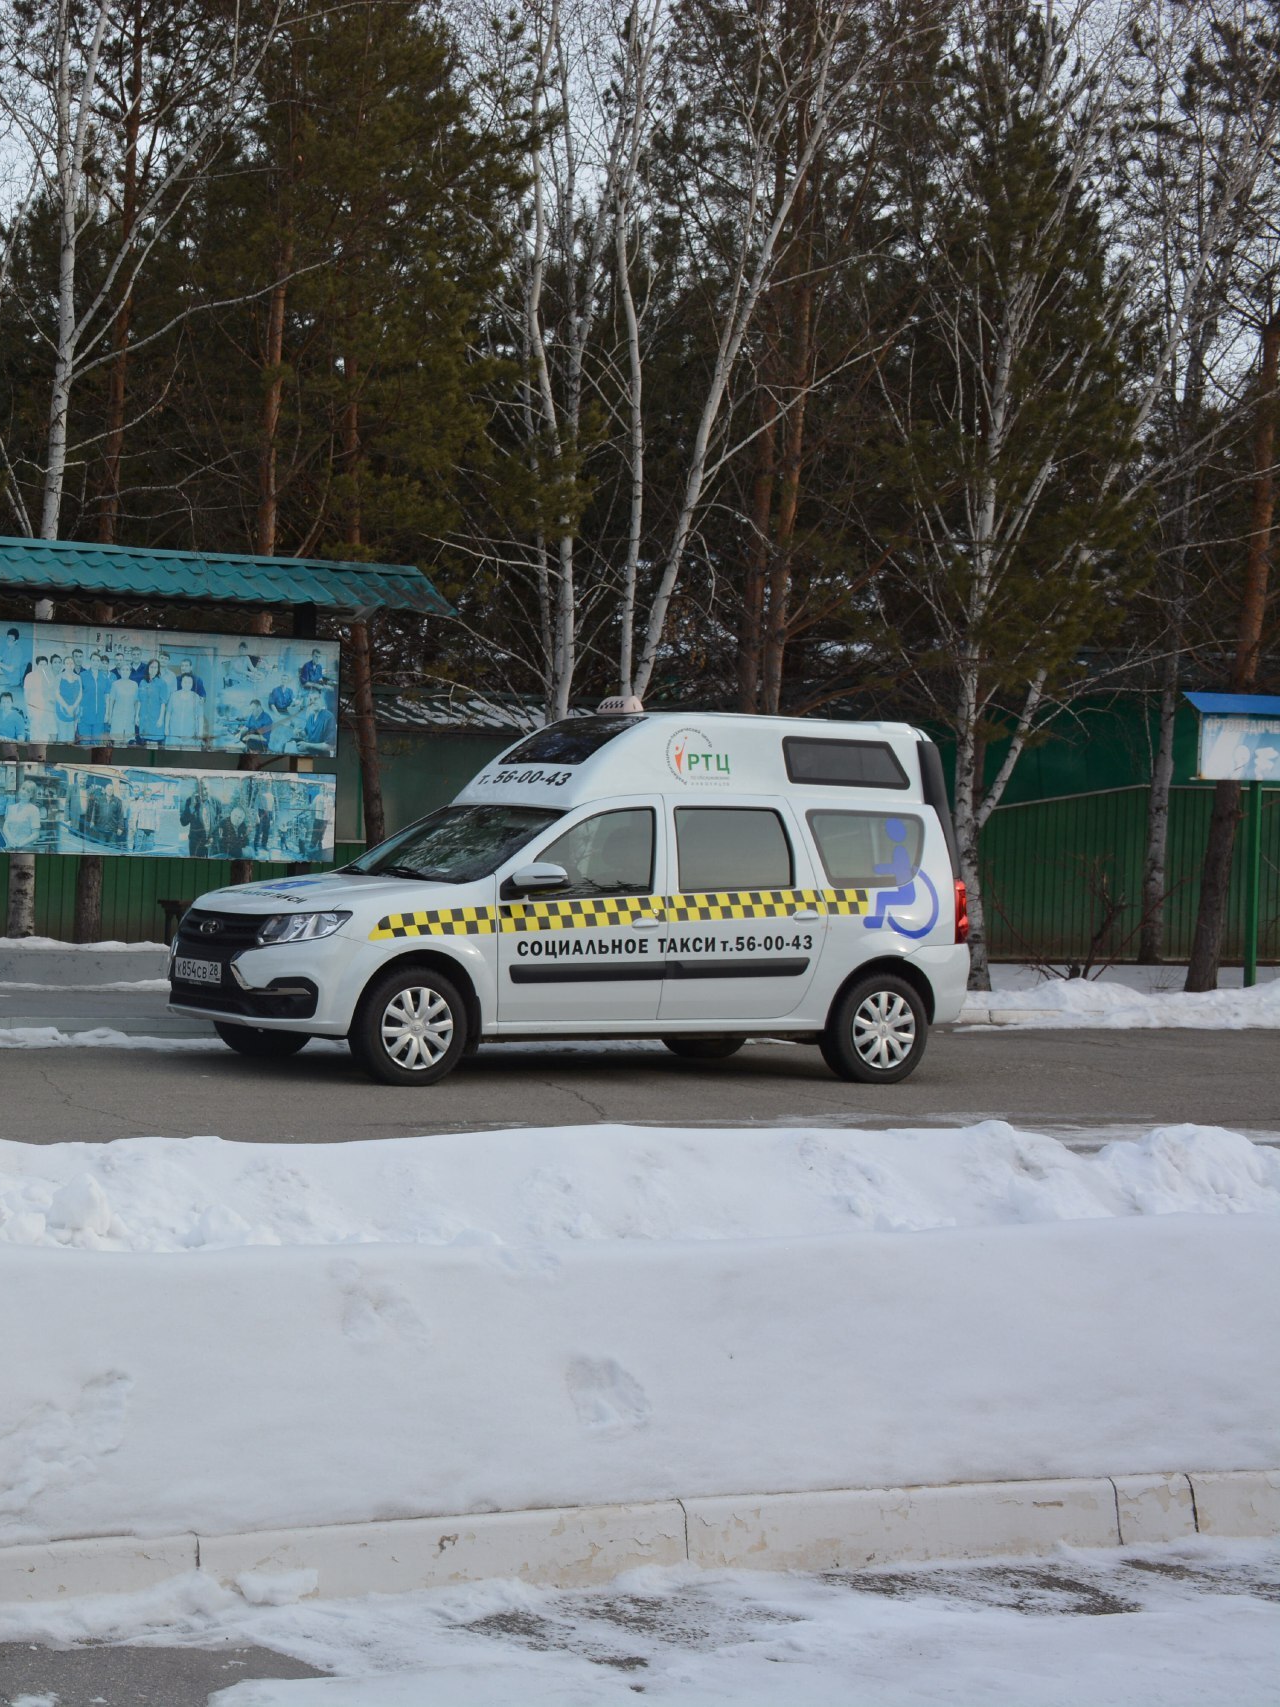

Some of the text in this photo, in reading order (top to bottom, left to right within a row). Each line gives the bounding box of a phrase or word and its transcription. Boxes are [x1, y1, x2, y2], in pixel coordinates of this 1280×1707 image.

[687, 753, 731, 775] РТЦ
[492, 769, 573, 787] 56-00-43
[516, 938, 649, 958] СОЦИАЛЬНОЕ
[657, 936, 716, 953] ТАКСИ
[209, 963, 219, 976] 28
